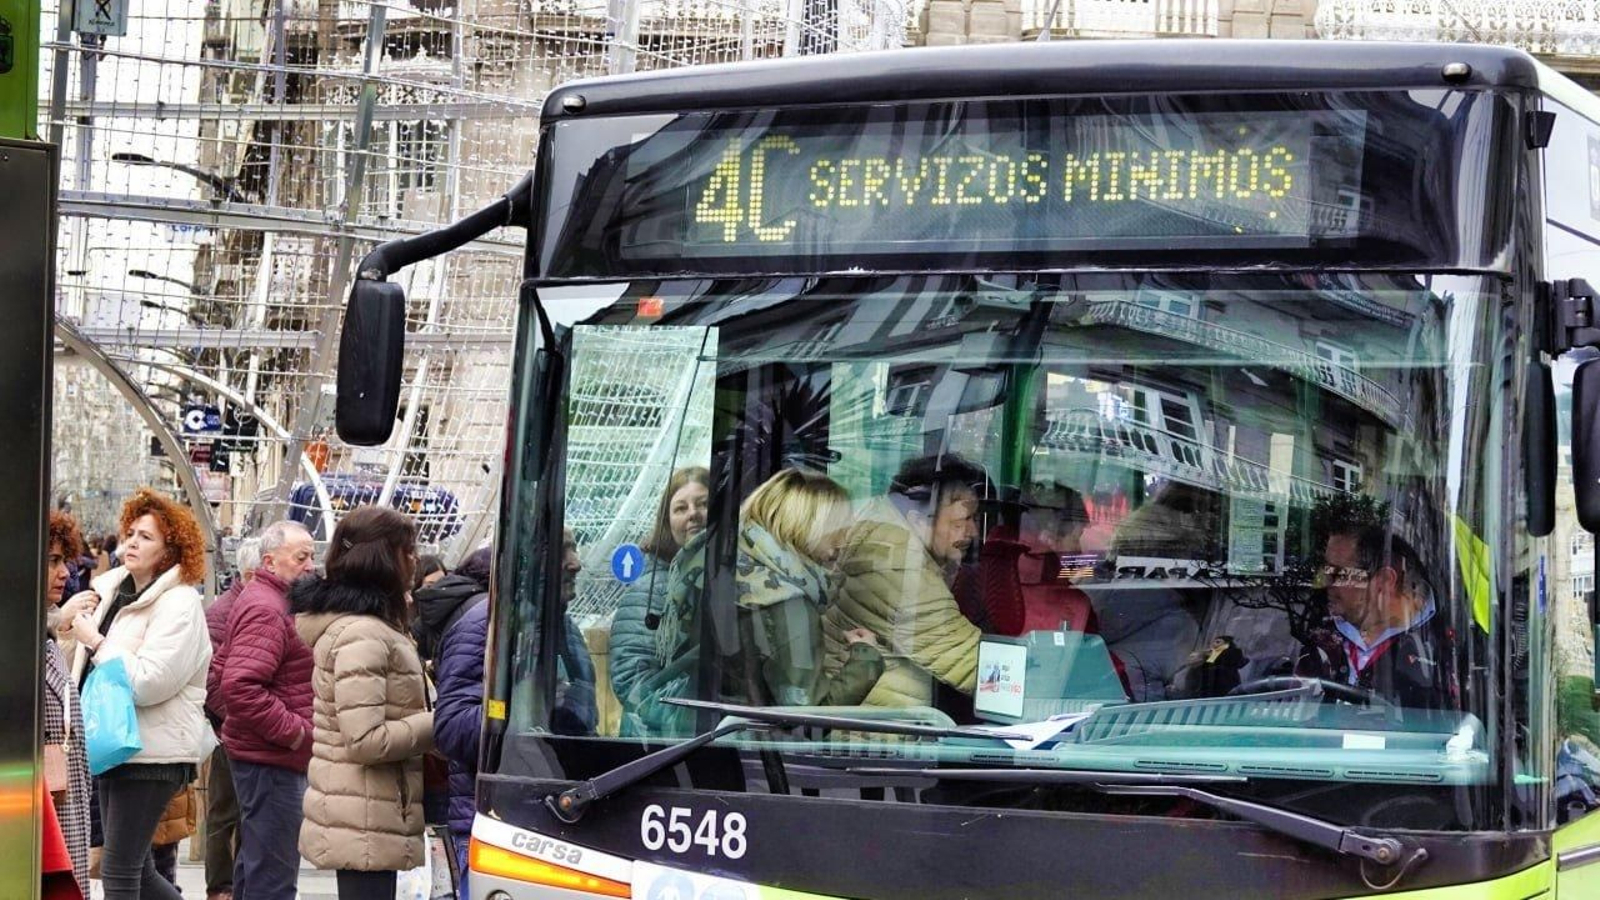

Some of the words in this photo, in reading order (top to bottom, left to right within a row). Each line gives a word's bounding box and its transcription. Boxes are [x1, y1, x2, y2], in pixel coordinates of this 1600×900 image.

[695, 134, 800, 243] 4C
[809, 152, 1048, 208] SERVIZOS
[511, 831, 582, 865] carsa
[641, 803, 747, 859] 6548
